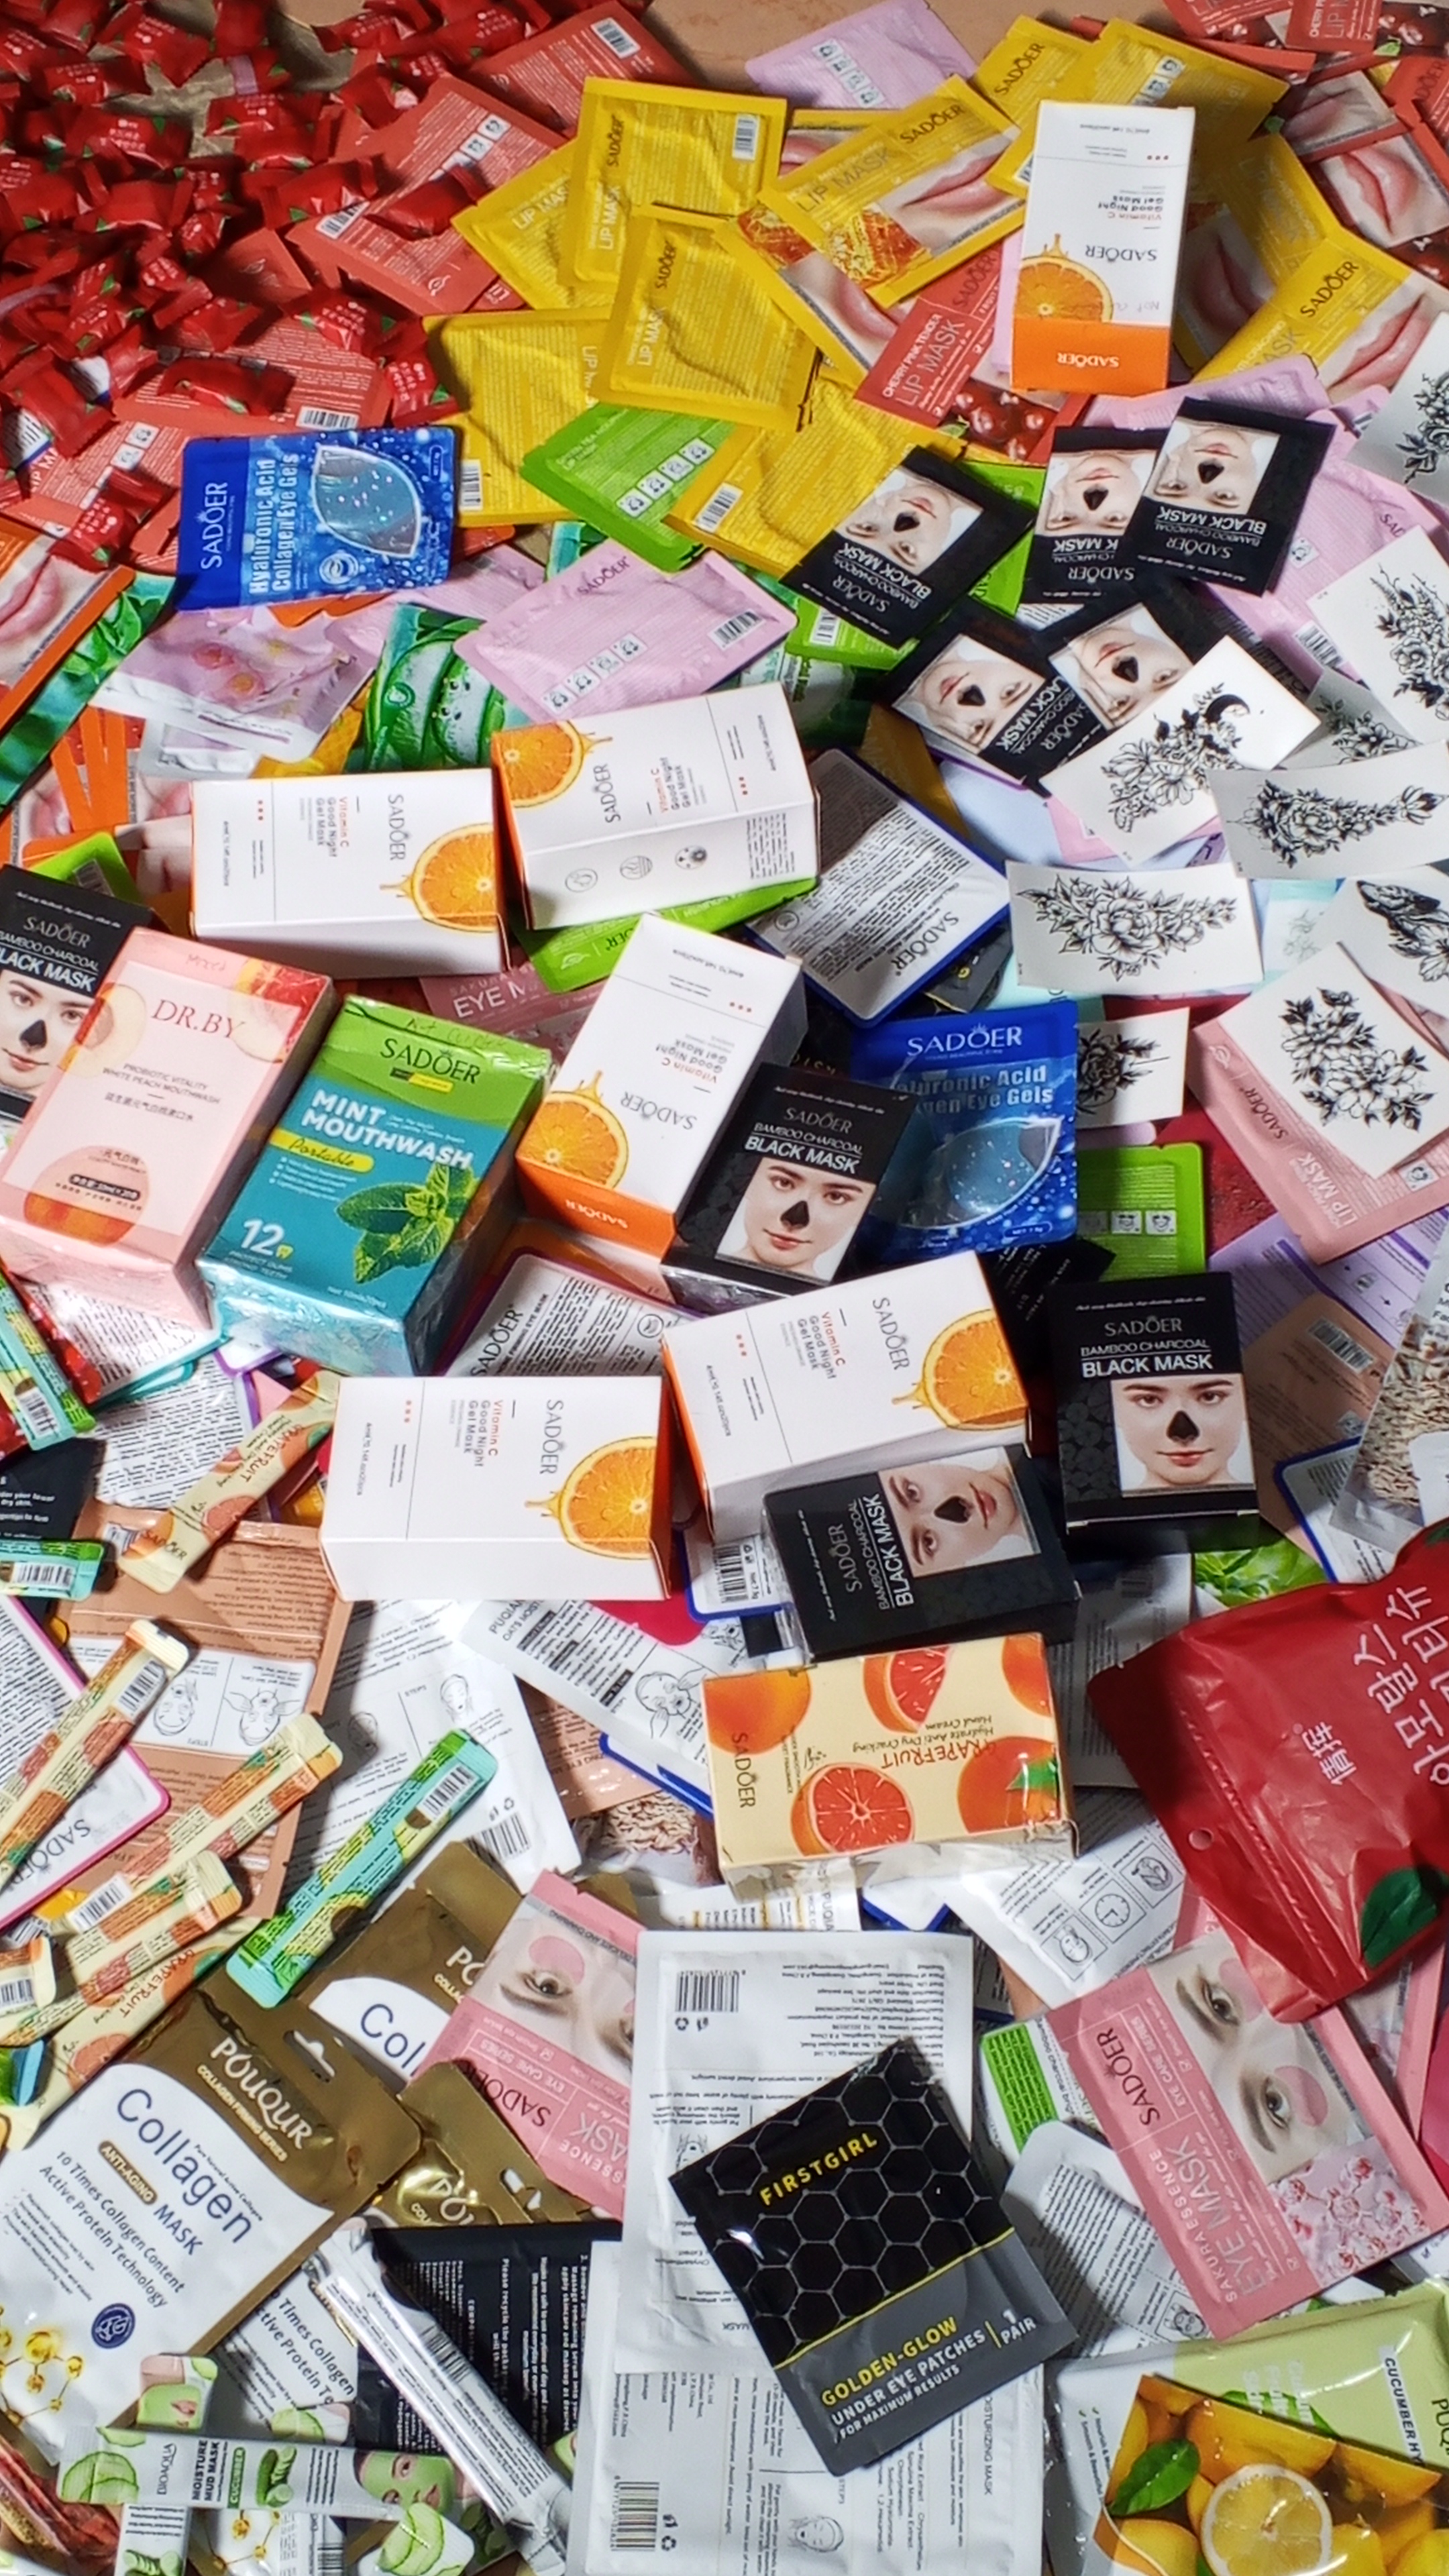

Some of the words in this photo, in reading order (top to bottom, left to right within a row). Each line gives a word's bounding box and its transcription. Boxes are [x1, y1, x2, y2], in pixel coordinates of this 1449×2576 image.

[1085, 245, 1157, 262] SADOER
[1301, 260, 1359, 319] SADOER
[896, 374, 922, 405] LIP
[926, 319, 965, 374] MASK
[1057, 353, 1119, 368] SADOER
[256, 459, 276, 498] Acid
[282, 453, 299, 488] Gels
[278, 489, 297, 519] Eye
[1158, 506, 1208, 523] MASK
[201, 482, 228, 570] SADOER
[1210, 516, 1268, 535] BLACK
[250, 498, 274, 594] Hyaluronic
[272, 519, 295, 592] Collagen
[839, 542, 883, 571] MASK
[1053, 539, 1105, 553] MASK
[881, 562, 931, 600] BLACK
[996, 708, 1036, 751] MASK
[660, 757, 673, 785] Night
[674, 765, 686, 790] Mask
[315, 798, 325, 817] Gel
[593, 763, 621, 823] SADOER
[655, 777, 669, 813] Vitamin
[667, 784, 680, 810] Good
[680, 792, 691, 808] Gel
[327, 797, 336, 827] Good
[339, 797, 348, 841] Vitamin
[388, 794, 410, 861] SADOER
[316, 819, 326, 845] Mask
[327, 828, 338, 857] Night
[340, 839, 350, 847] C
[23, 916, 91, 949] SADOER
[44, 964, 97, 992] MASK
[152, 999, 246, 1038] DR.BY
[453, 985, 506, 1018] EYE
[674, 1038, 706, 1056] Mask
[708, 1047, 729, 1065] Gel
[907, 1024, 1022, 1057] SADOER
[380, 1038, 481, 1084] SADOER
[661, 1057, 672, 1067] C
[674, 1062, 719, 1084] Vitamin
[689, 1055, 724, 1074] Good
[998, 1065, 1047, 1086] Acid
[102, 1067, 131, 1081] WHITE
[132, 1075, 162, 1089] PEACH
[163, 1081, 221, 1104] MOUTHWASH
[1007, 1086, 1053, 1106] Gels
[311, 1089, 387, 1126] MINT
[620, 1091, 698, 1130] SADOER
[784, 1107, 853, 1134] SADOER
[289, 1137, 356, 1167] Portable
[301, 1108, 474, 1169] MOUTHWASH
[745, 1136, 805, 1160] BLACK
[804, 1148, 860, 1174] MASK
[1298, 1151, 1340, 1199] MASK
[1332, 1201, 1358, 1226] LIP
[241, 1218, 284, 1256] 12
[798, 1318, 811, 1340] Gel
[821, 1311, 841, 1355] Vitamin
[835, 1356, 846, 1366] C
[872, 1297, 910, 1371] SADOER
[1104, 1316, 1183, 1337] SADOER
[804, 1340, 818, 1370] Mask
[809, 1315, 826, 1348] Good
[818, 1347, 837, 1380] Night
[1082, 1356, 1150, 1378] BLACK
[1154, 1354, 1214, 1371] MASK
[467, 1400, 479, 1423] Gel
[478, 1400, 491, 1434] Good
[490, 1400, 502, 1446] Vitamin
[464, 1424, 476, 1454] Mask
[474, 1436, 487, 1467] Night
[488, 1448, 498, 1456] C
[539, 1398, 565, 1475] SADOER
[863, 1493, 895, 1544] MASK
[828, 1523, 863, 1593] SADOER
[880, 1545, 914, 1607] BLACK
[925, 1719, 961, 1729] Cream
[963, 1716, 992, 1724] Hand
[901, 1735, 922, 1745] Dry
[924, 1733, 948, 1743] Anti
[1096, 2027, 1161, 2126] SADOER
[116, 2088, 252, 2245] Collagen
[759, 2132, 879, 2207] FIRSTGIRL
[1166, 2135, 1233, 2232] MASK
[100, 2144, 155, 2204] ANTI-AGING
[153, 2203, 204, 2257] MASK
[1148, 2149, 1201, 2232] ESSENCE
[39, 2166, 75, 2204] Active
[72, 2201, 113, 2247] Protein
[112, 2243, 168, 2312] Technology
[56, 2151, 72, 2166] 10
[70, 2163, 103, 2201] Times
[101, 2200, 146, 2251] Collagen
[143, 2248, 186, 2294] Content
[1191, 2232, 1238, 2304] SAKURA
[1214, 2229, 1269, 2296] EYE
[999, 2316, 1037, 2345] PAIR
[1002, 2308, 1017, 2324] 1
[279, 2298, 312, 2340] Times
[309, 2339, 354, 2396] Collagen
[280, 2339, 321, 2389] Protein
[819, 2316, 960, 2408] GOLDEN-GLOW
[830, 2384, 887, 2426] UNDER
[888, 2366, 917, 2396] EYE
[916, 2328, 987, 2377] PATCHES
[838, 2418, 863, 2440] FOR
[861, 2390, 914, 2424] MAXIMUM
[914, 2363, 961, 2399] RESULTS
[1383, 2355, 1416, 2439] CUCUMBER
[191, 2439, 208, 2501] MOISTURE
[203, 2473, 215, 2502] MUD
[211, 2441, 221, 2472] MASK
[983, 2465, 993, 2495] MASK
